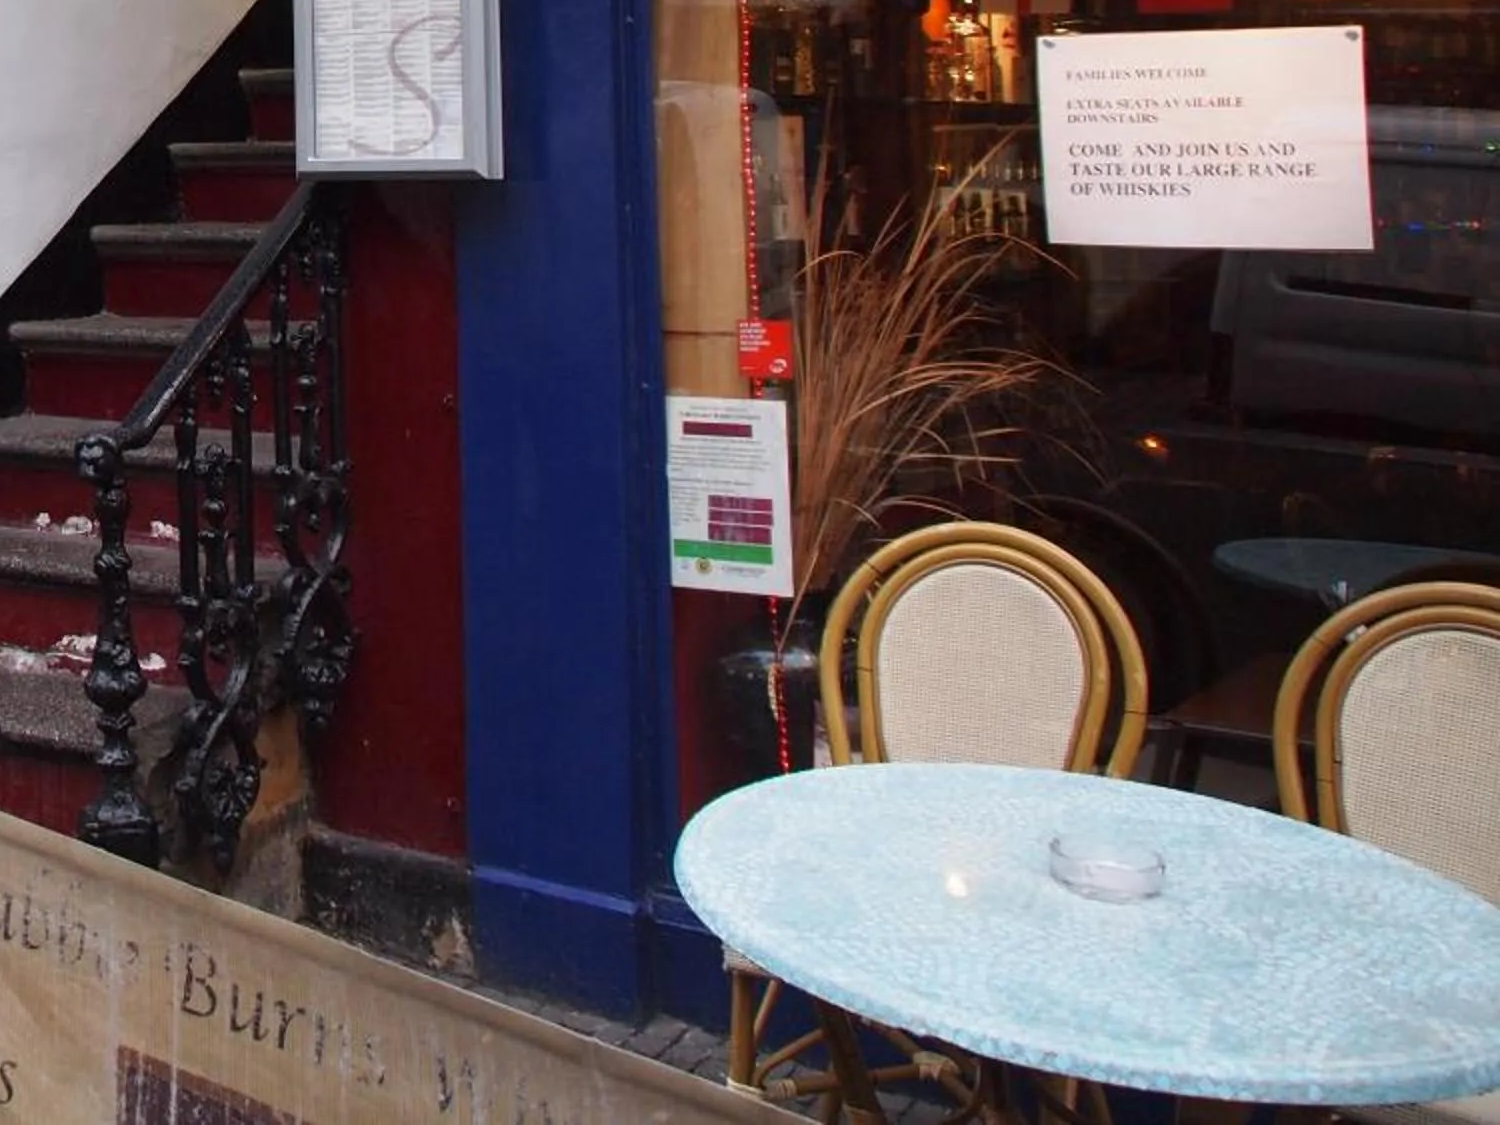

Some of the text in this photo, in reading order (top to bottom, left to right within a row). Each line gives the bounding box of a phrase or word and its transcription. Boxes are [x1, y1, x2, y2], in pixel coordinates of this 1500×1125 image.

[1066, 67, 1207, 82] FAMILIES WELCOME
[1066, 96, 1244, 111] EXTRA SEATS AVAILABLE
[1067, 113, 1159, 124] DOWNSTAIRS
[1068, 143, 1296, 157] COME AND JOIN US AND
[1069, 163, 1319, 177] TASTE OUR LARGE RANGE
[1070, 183, 1192, 197] OF WHISKIES
